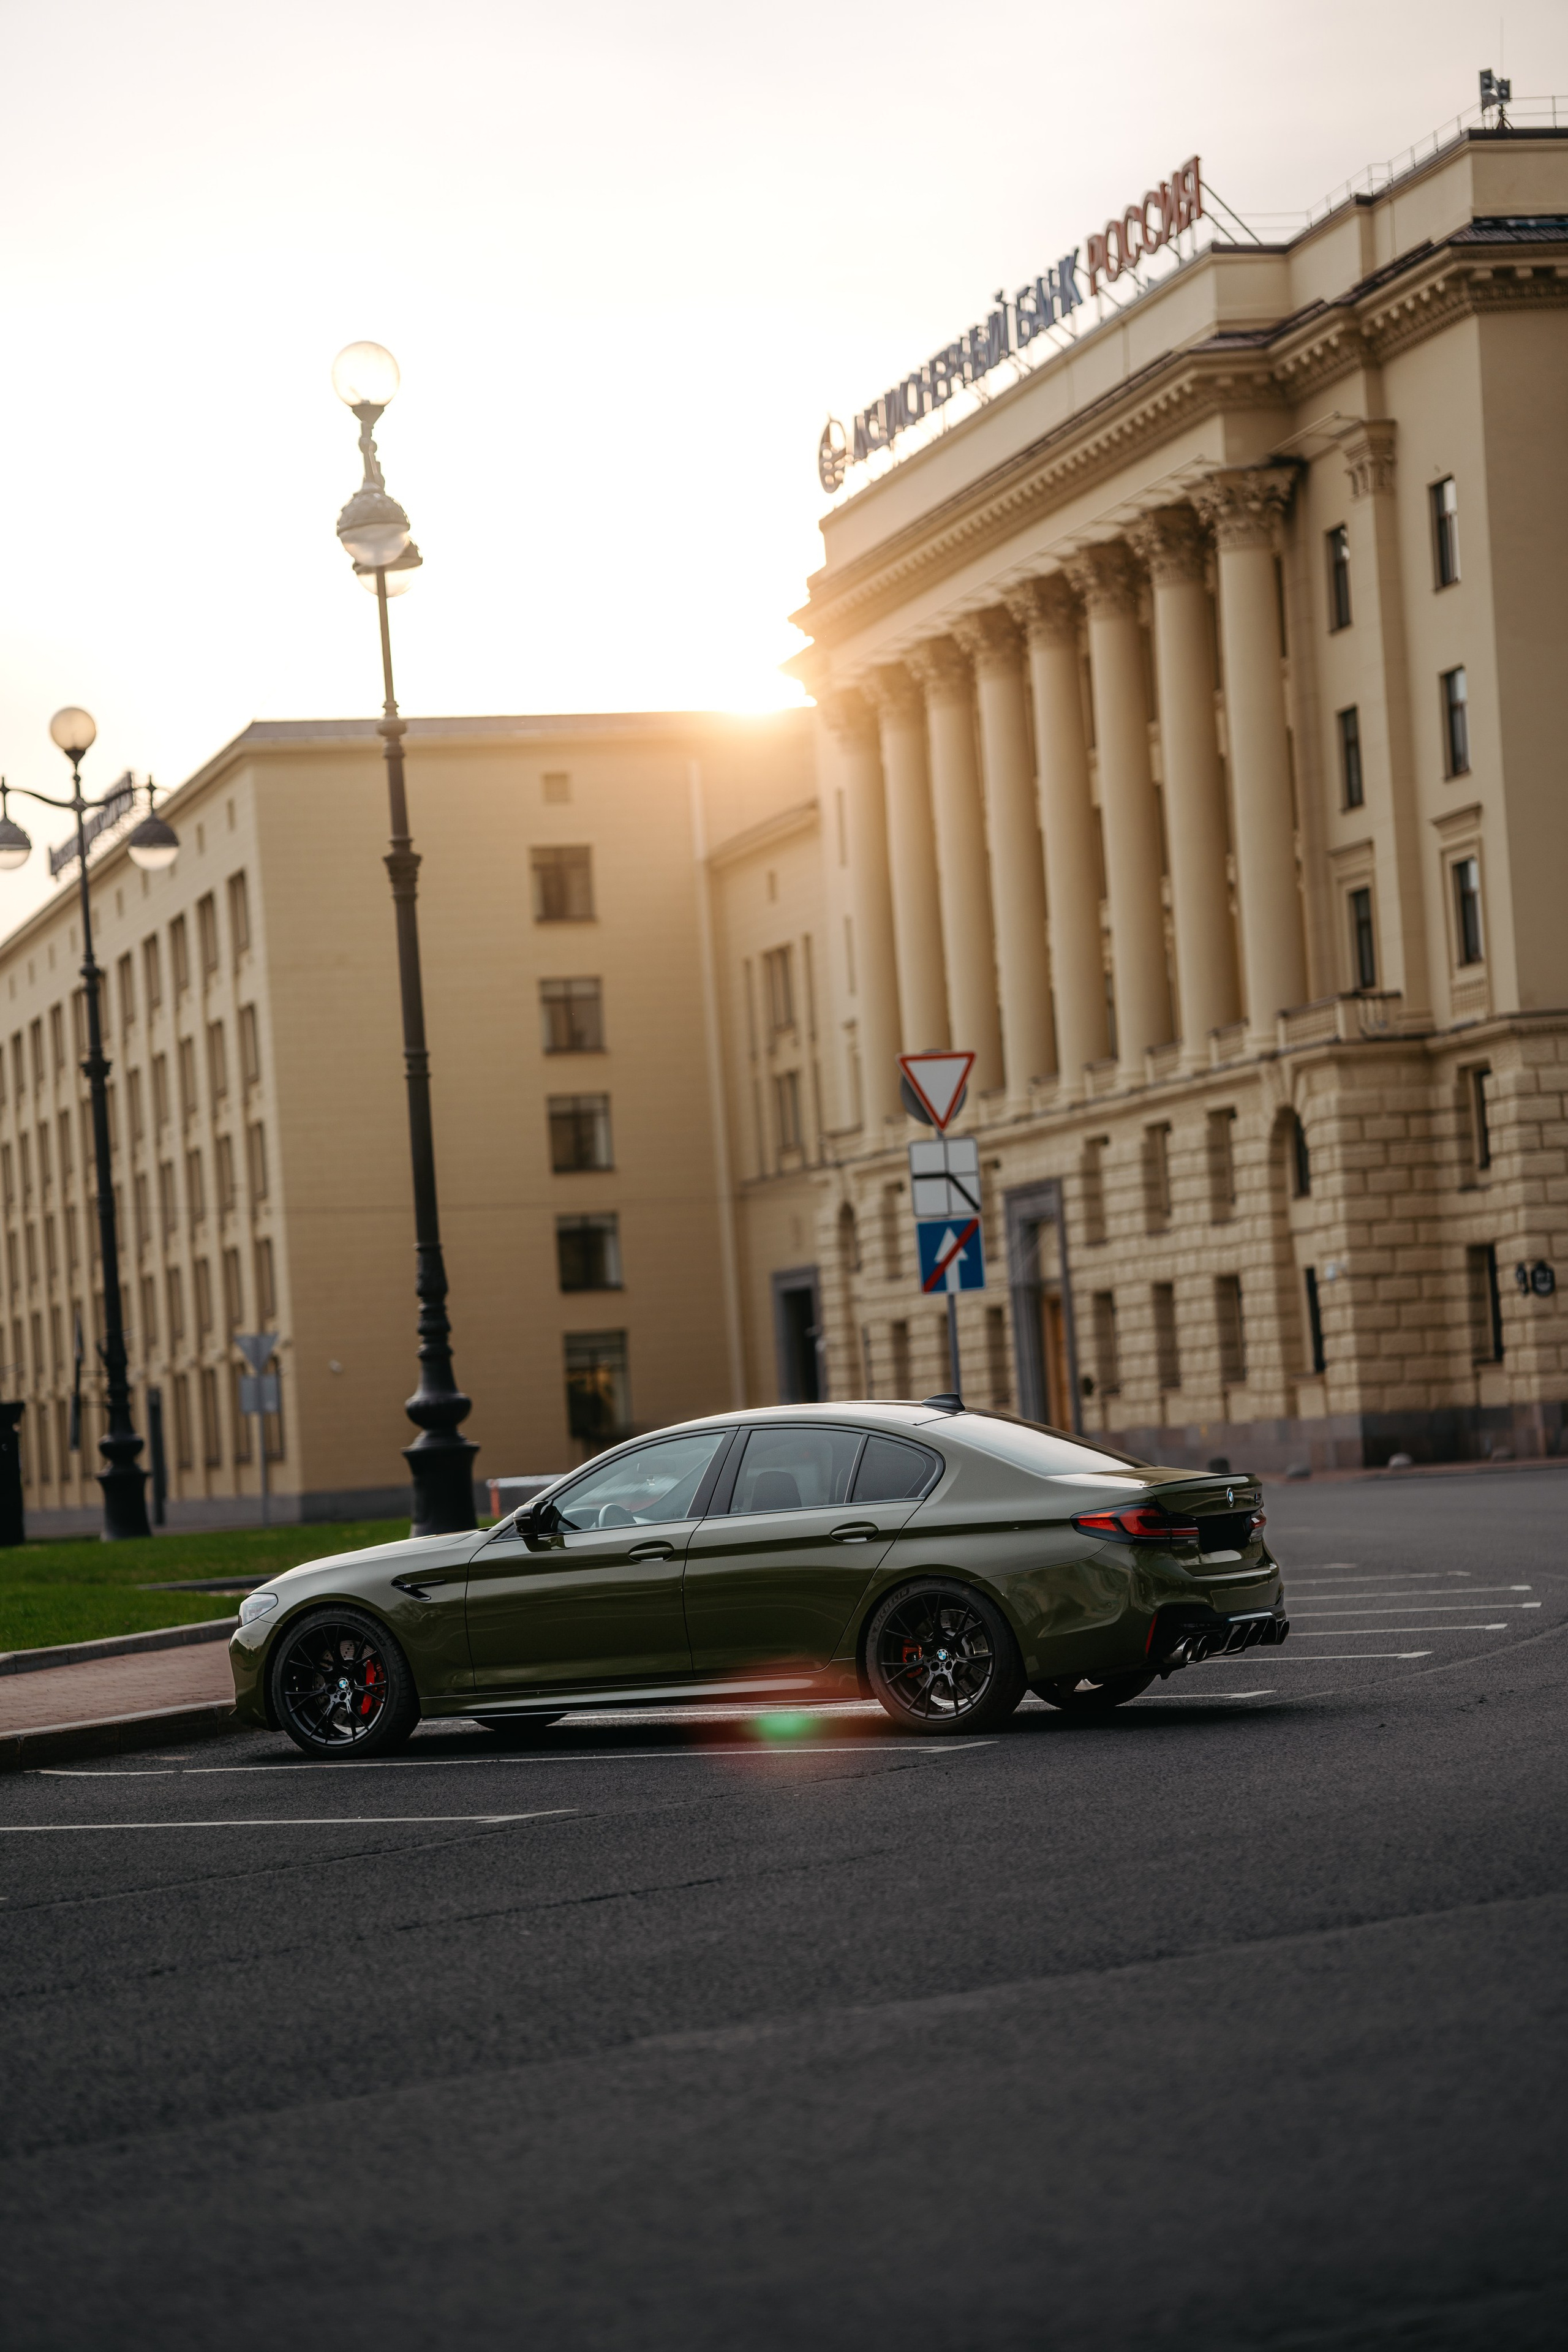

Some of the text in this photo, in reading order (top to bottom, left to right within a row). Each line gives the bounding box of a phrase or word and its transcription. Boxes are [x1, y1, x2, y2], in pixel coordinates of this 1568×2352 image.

[1017, 247, 1083, 349] БАНК
[1088, 156, 1200, 296] РОССИЯ
[874, 1588, 909, 1630] MICHELIN
